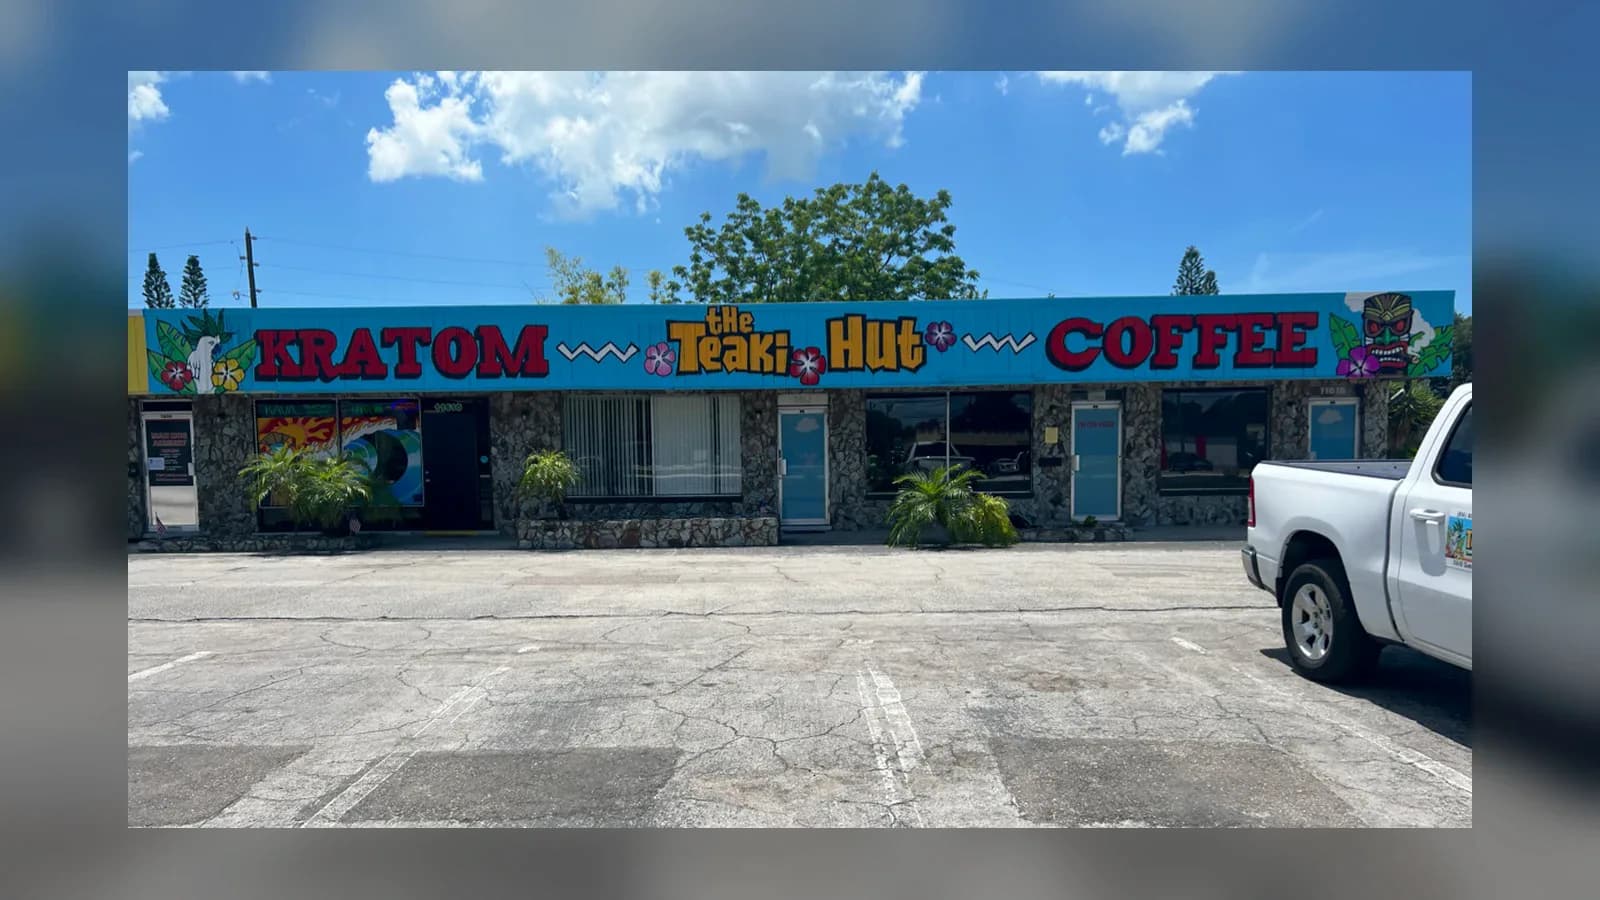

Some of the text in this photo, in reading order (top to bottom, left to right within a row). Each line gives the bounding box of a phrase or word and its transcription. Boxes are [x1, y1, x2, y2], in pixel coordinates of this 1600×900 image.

[254, 324, 549, 382] KRATOM
[826, 313, 927, 374] Hut
[1045, 312, 1319, 372] COFFEE
